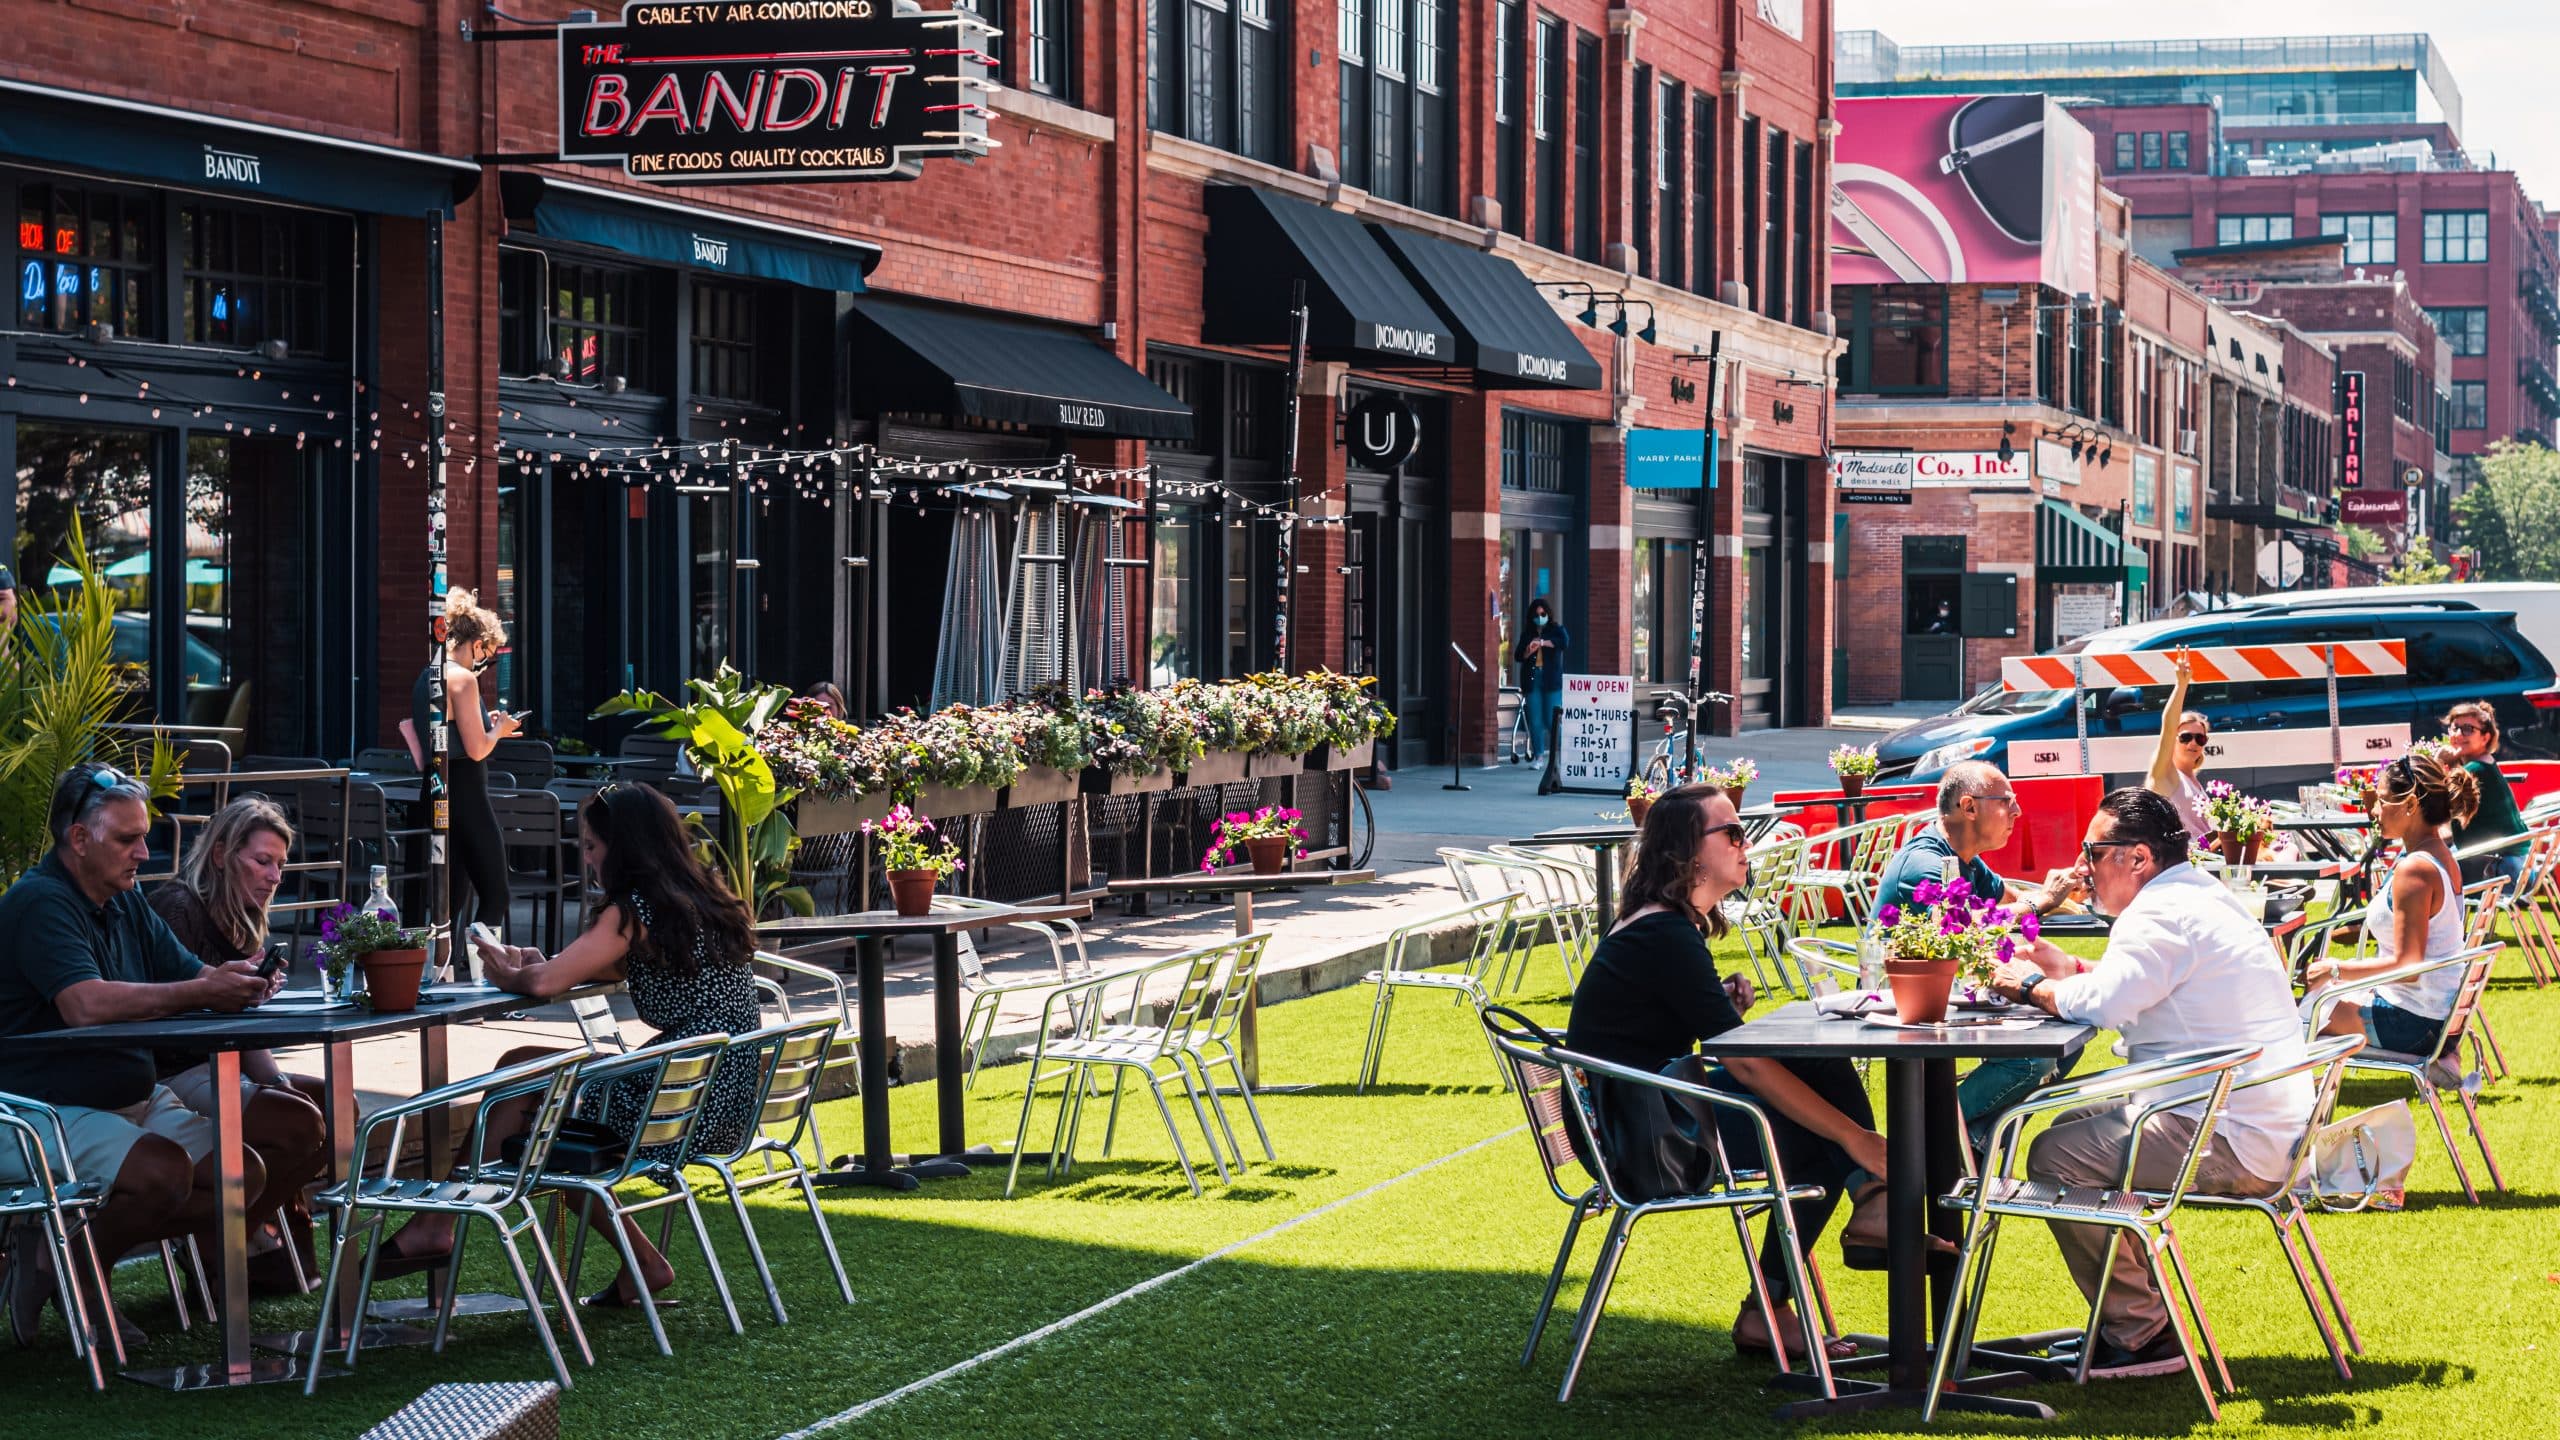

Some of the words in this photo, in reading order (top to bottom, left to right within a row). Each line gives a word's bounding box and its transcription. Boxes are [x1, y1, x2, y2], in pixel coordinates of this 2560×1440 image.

[637, 6, 692, 25] CABLE
[696, 5, 720, 23] TV
[726, 3, 755, 21] AIR
[756, 0, 872, 20] CONDITIONED
[581, 44, 624, 65] THE
[579, 65, 916, 138] BANDIT
[205, 154, 260, 184] BANDIT
[631, 154, 665, 172] FINE
[668, 152, 723, 170] FOODS
[730, 148, 797, 168] QUALITY
[800, 147, 886, 167] COCKTAILS
[693, 240, 728, 267] BANDIT
[1060, 404, 1082, 425] BILLY
[1083, 407, 1105, 427] REID
[2345, 376, 2359, 484] ITALIAN
[1638, 455, 1670, 463] WARBY
[1846, 460, 1908, 476] Madewell
[1917, 455, 1964, 477] Co.,
[1973, 454, 2018, 474] Inc.
[1850, 477, 1878, 485] denim
[1569, 680, 1591, 691] NOW
[1597, 681, 1629, 693] OPEN!
[1582, 723, 1608, 735] 10-7
[1582, 751, 1608, 763] 10-8
[1566, 765, 1587, 777] SUN
[1594, 766, 1621, 778] 11-5
